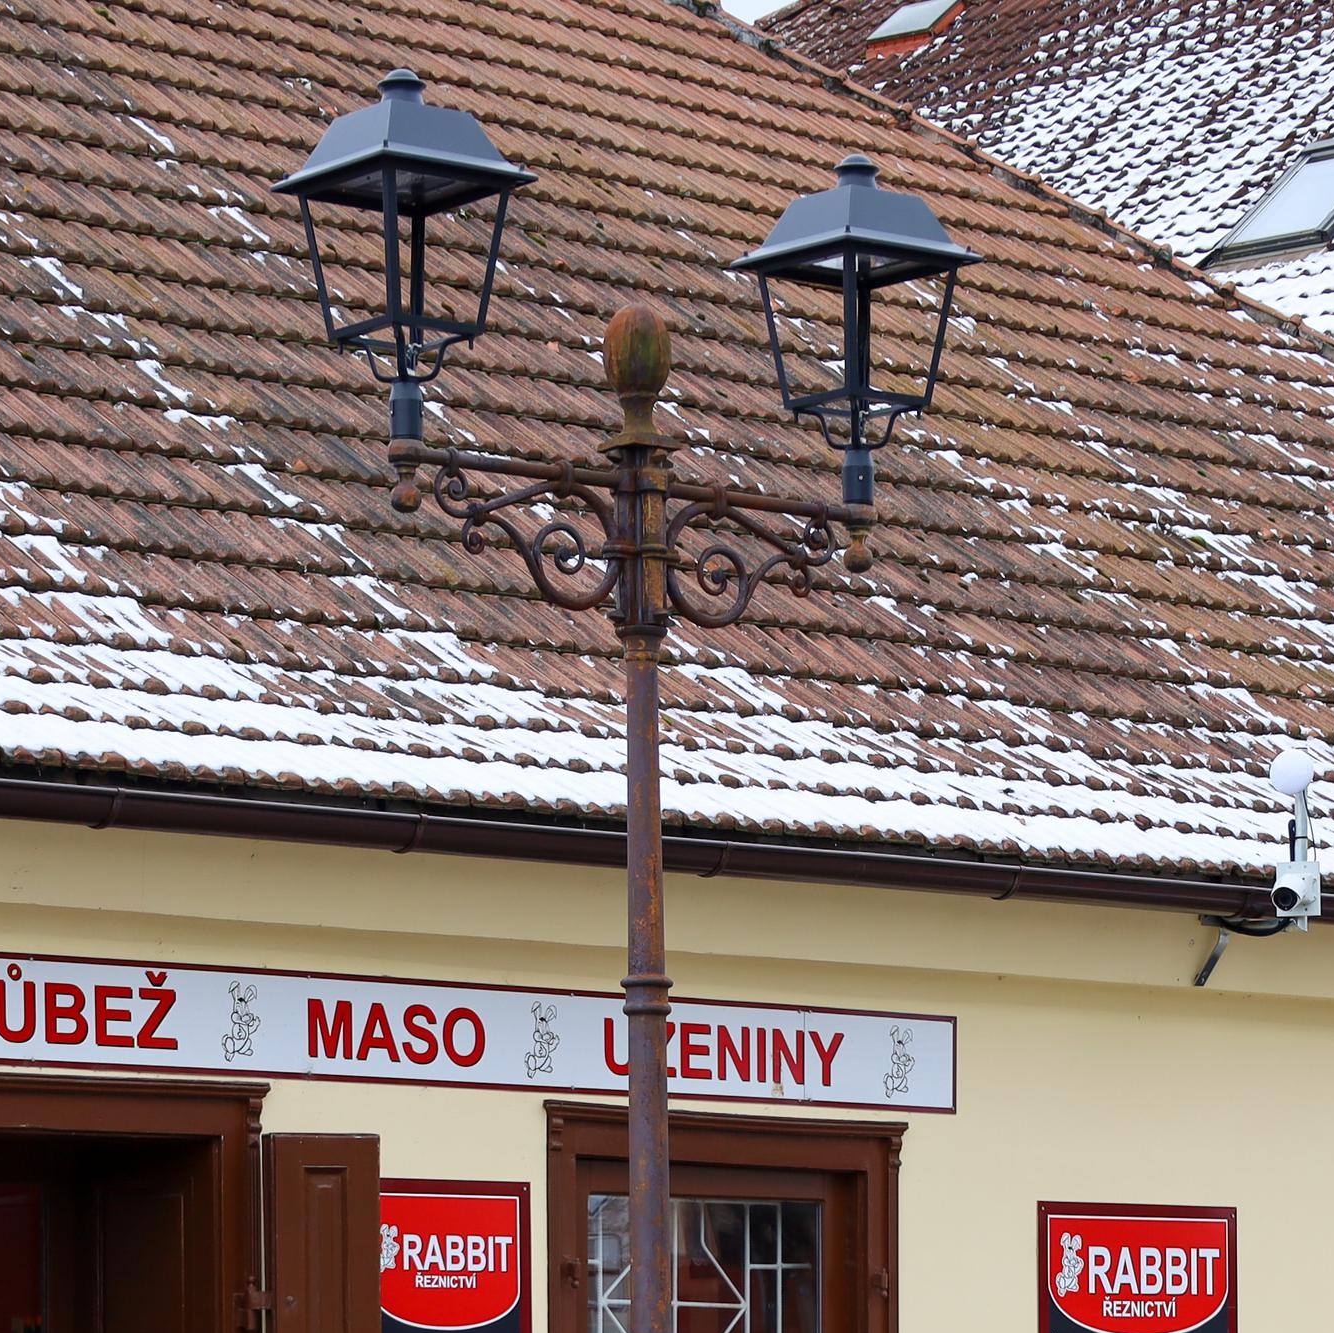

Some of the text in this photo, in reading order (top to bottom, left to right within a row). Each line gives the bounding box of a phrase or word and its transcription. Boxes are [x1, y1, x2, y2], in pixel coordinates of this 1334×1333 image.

[306, 998, 486, 1067] MASO
[402, 1234, 514, 1273] RABBIT
[1087, 1245, 1221, 1297] RABBIT
[415, 1271, 477, 1290] ŘEZNICTVÍ
[1102, 1295, 1177, 1319] ŘEZNICTVÍ
